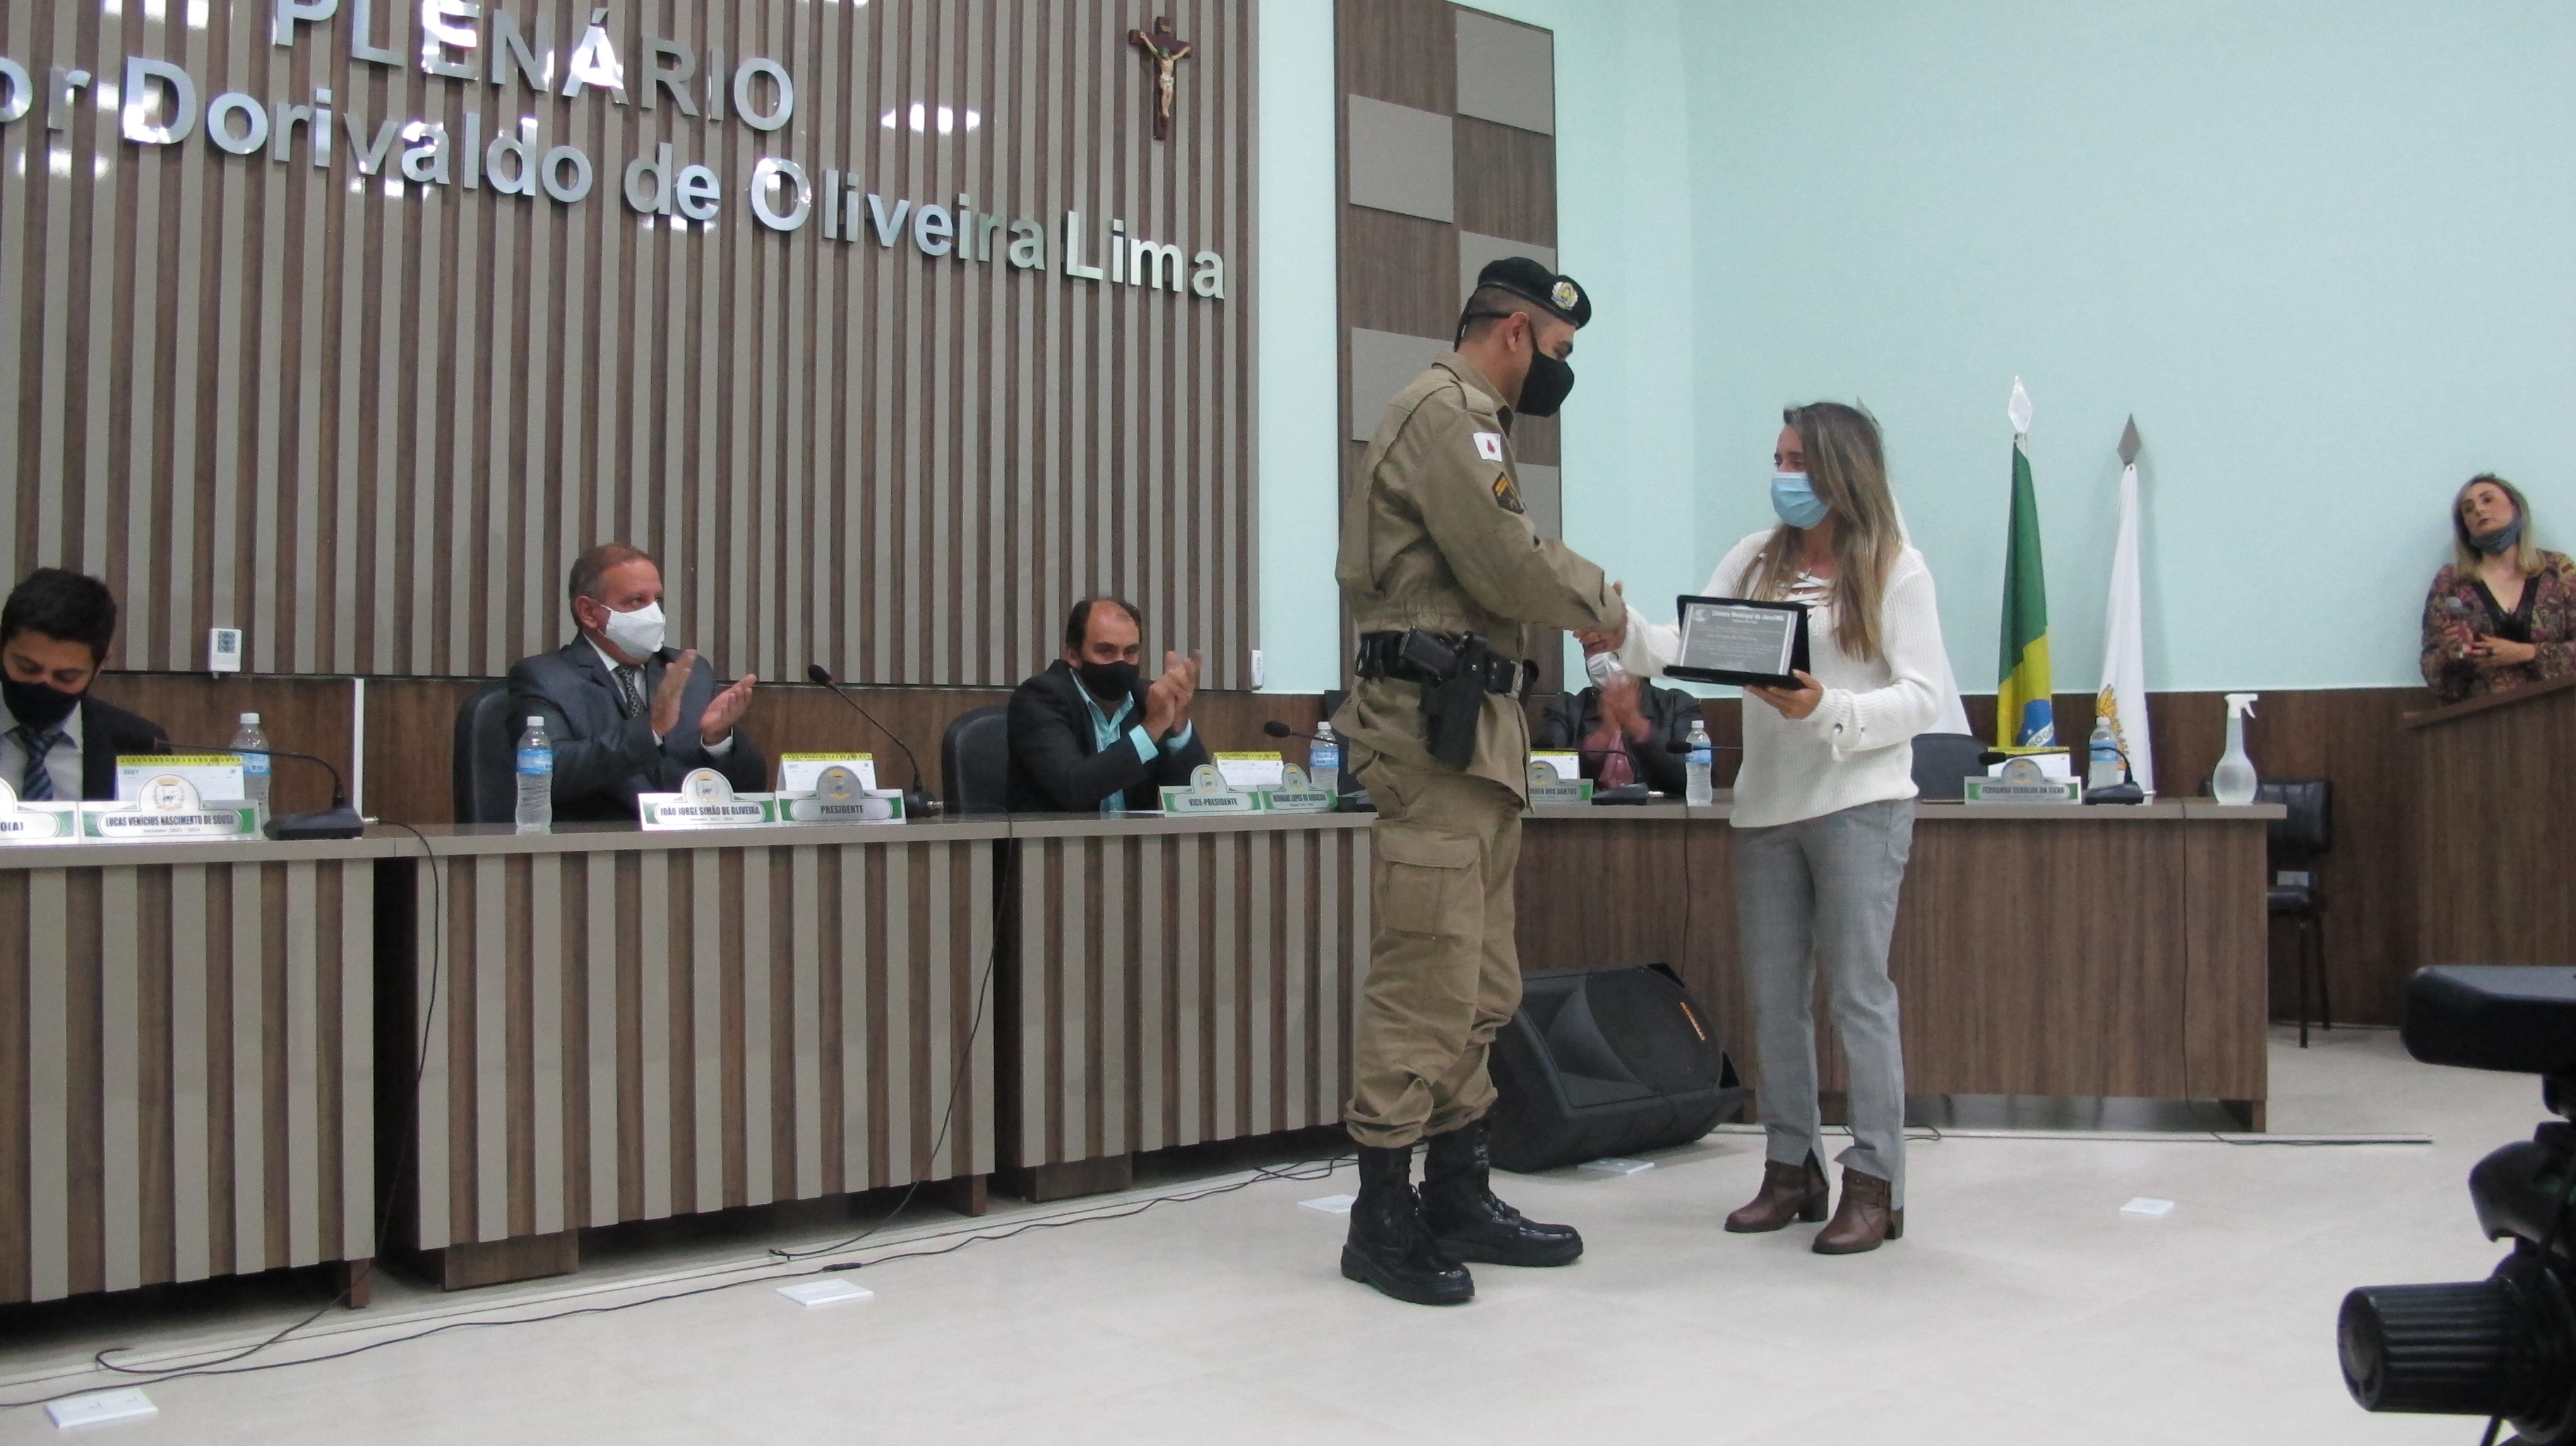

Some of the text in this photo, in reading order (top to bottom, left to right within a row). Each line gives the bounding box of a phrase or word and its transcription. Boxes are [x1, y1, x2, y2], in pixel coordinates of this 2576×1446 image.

[273, 0, 794, 131] PLENÁRIO
[121, 56, 593, 204] Dorivaldo
[624, 142, 722, 221] de
[750, 157, 1046, 272] Oliveira
[1065, 210, 1224, 300] Lima
[1188, 798, 1238, 807] VICE-PRESIDENTE
[678, 806, 698, 816] JORGE
[699, 805, 721, 815] SIMÃO
[722, 806, 730, 815] DE
[732, 806, 761, 815] OLIVEIRA
[821, 805, 864, 814] PRESIDENTE
[106, 816, 128, 827] LUCAS
[160, 815, 203, 826] NASCIMENTO
[203, 815, 213, 825] DE
